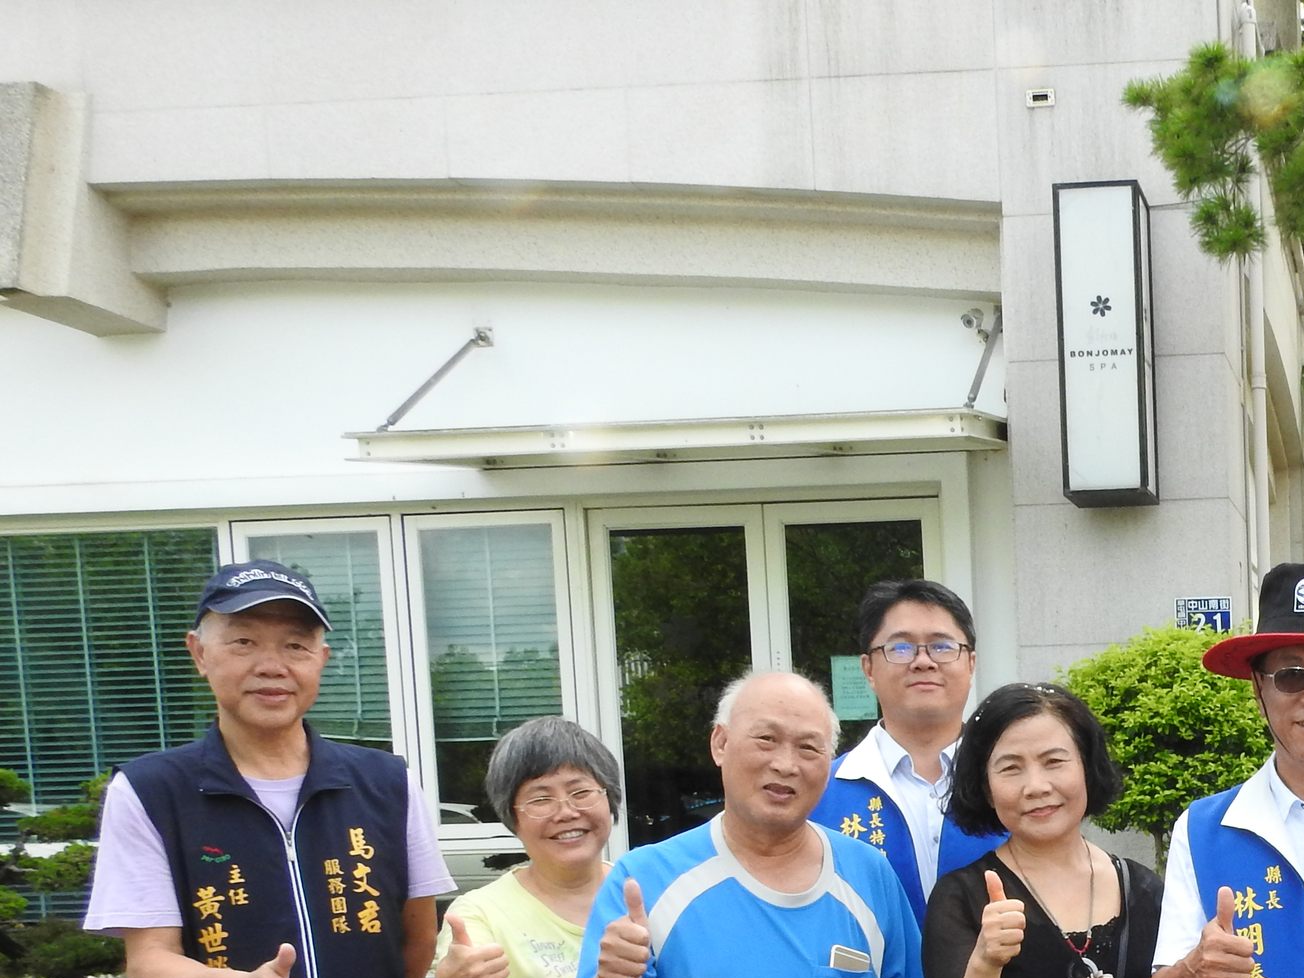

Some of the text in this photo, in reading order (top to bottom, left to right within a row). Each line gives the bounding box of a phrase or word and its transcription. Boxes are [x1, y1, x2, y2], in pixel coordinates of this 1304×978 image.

[1069, 348, 1133, 358] BONJOMAY
[1089, 362, 1117, 371] SPA
[1192, 612, 1222, 634] 21
[840, 813, 868, 839] 林
[228, 864, 249, 906] 主任
[323, 859, 351, 934] 服務團隊
[349, 827, 382, 934] 馬文君
[1264, 865, 1283, 910] 縣長
